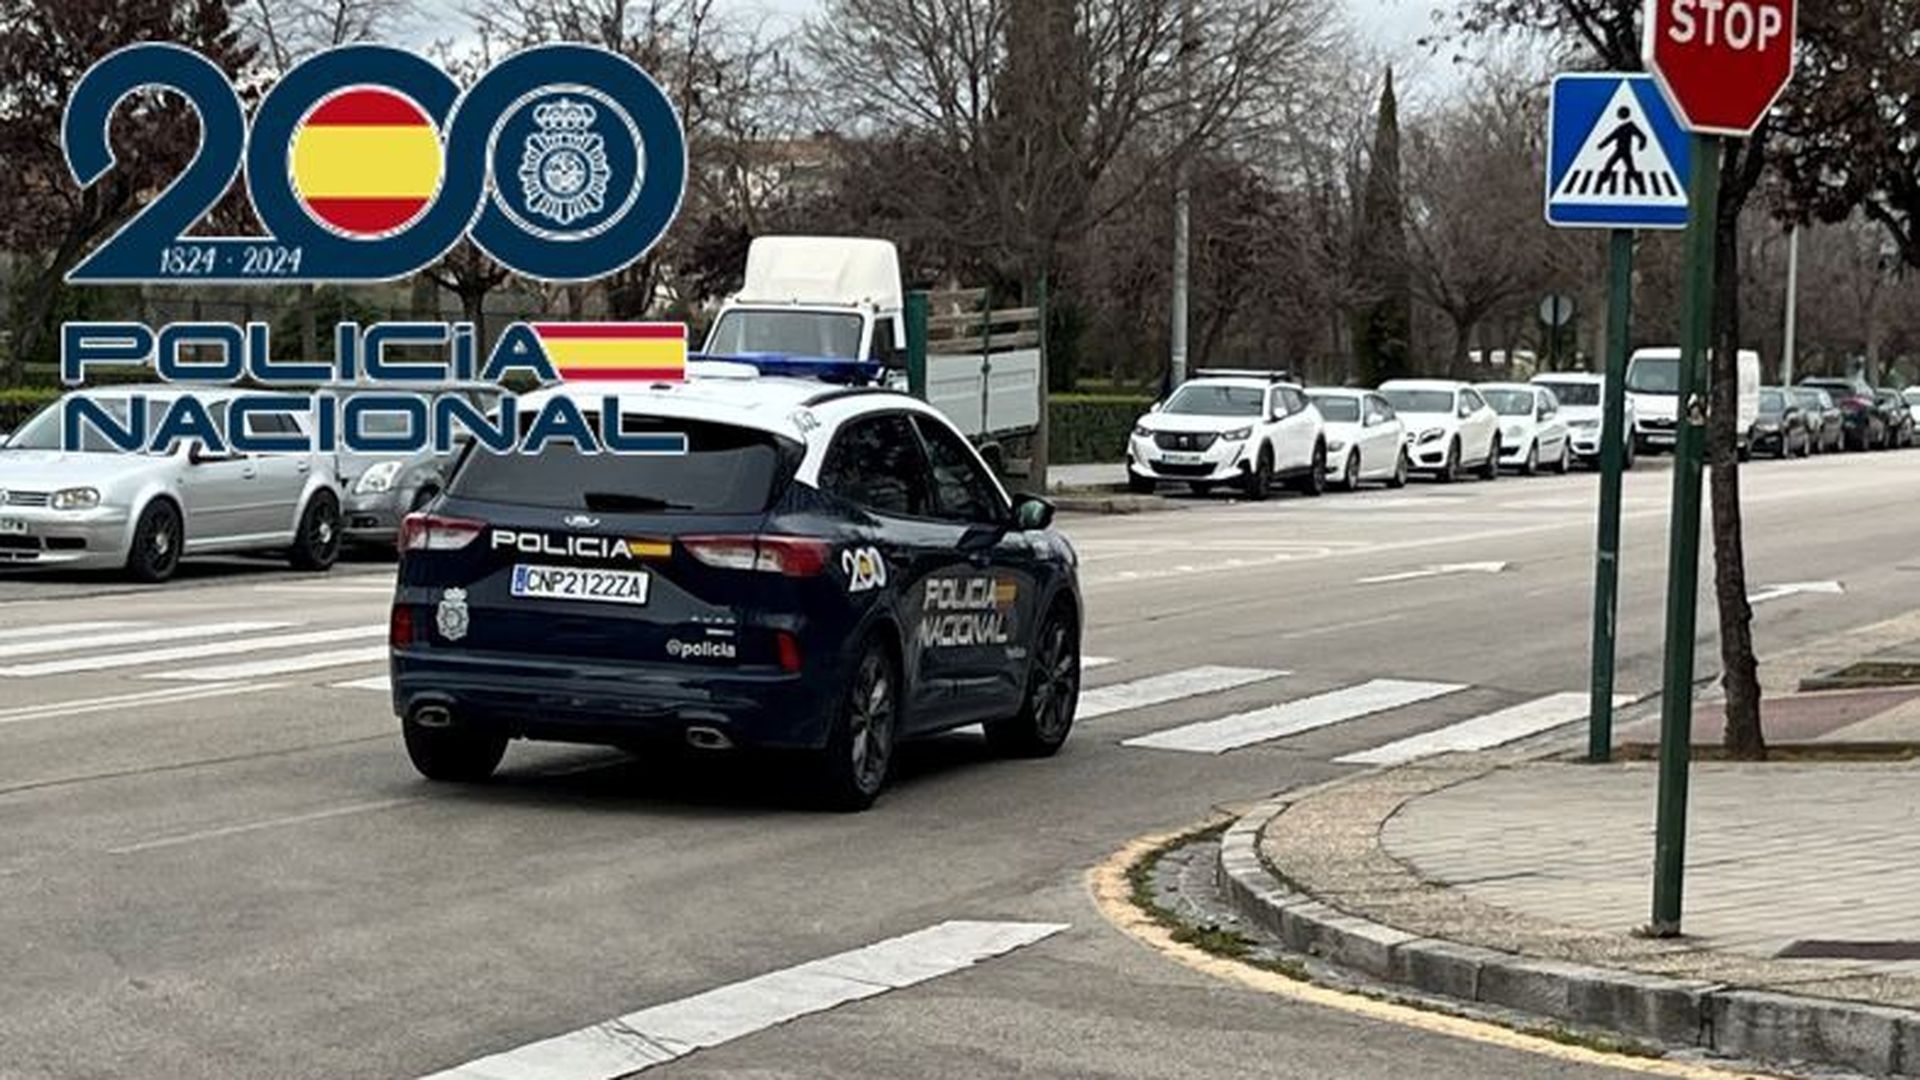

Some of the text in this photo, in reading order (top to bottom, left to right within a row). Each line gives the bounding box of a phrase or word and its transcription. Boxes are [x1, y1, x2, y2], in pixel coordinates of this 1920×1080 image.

[1668, 0, 1782, 51] STOP
[491, 529, 632, 559] POLICIA
[527, 569, 640, 598] CNP2122ZA
[842, 546, 887, 592] 200
[923, 579, 998, 611] POLICIA
[916, 614, 1008, 647] NACIONAL
[666, 639, 736, 658] @policia
